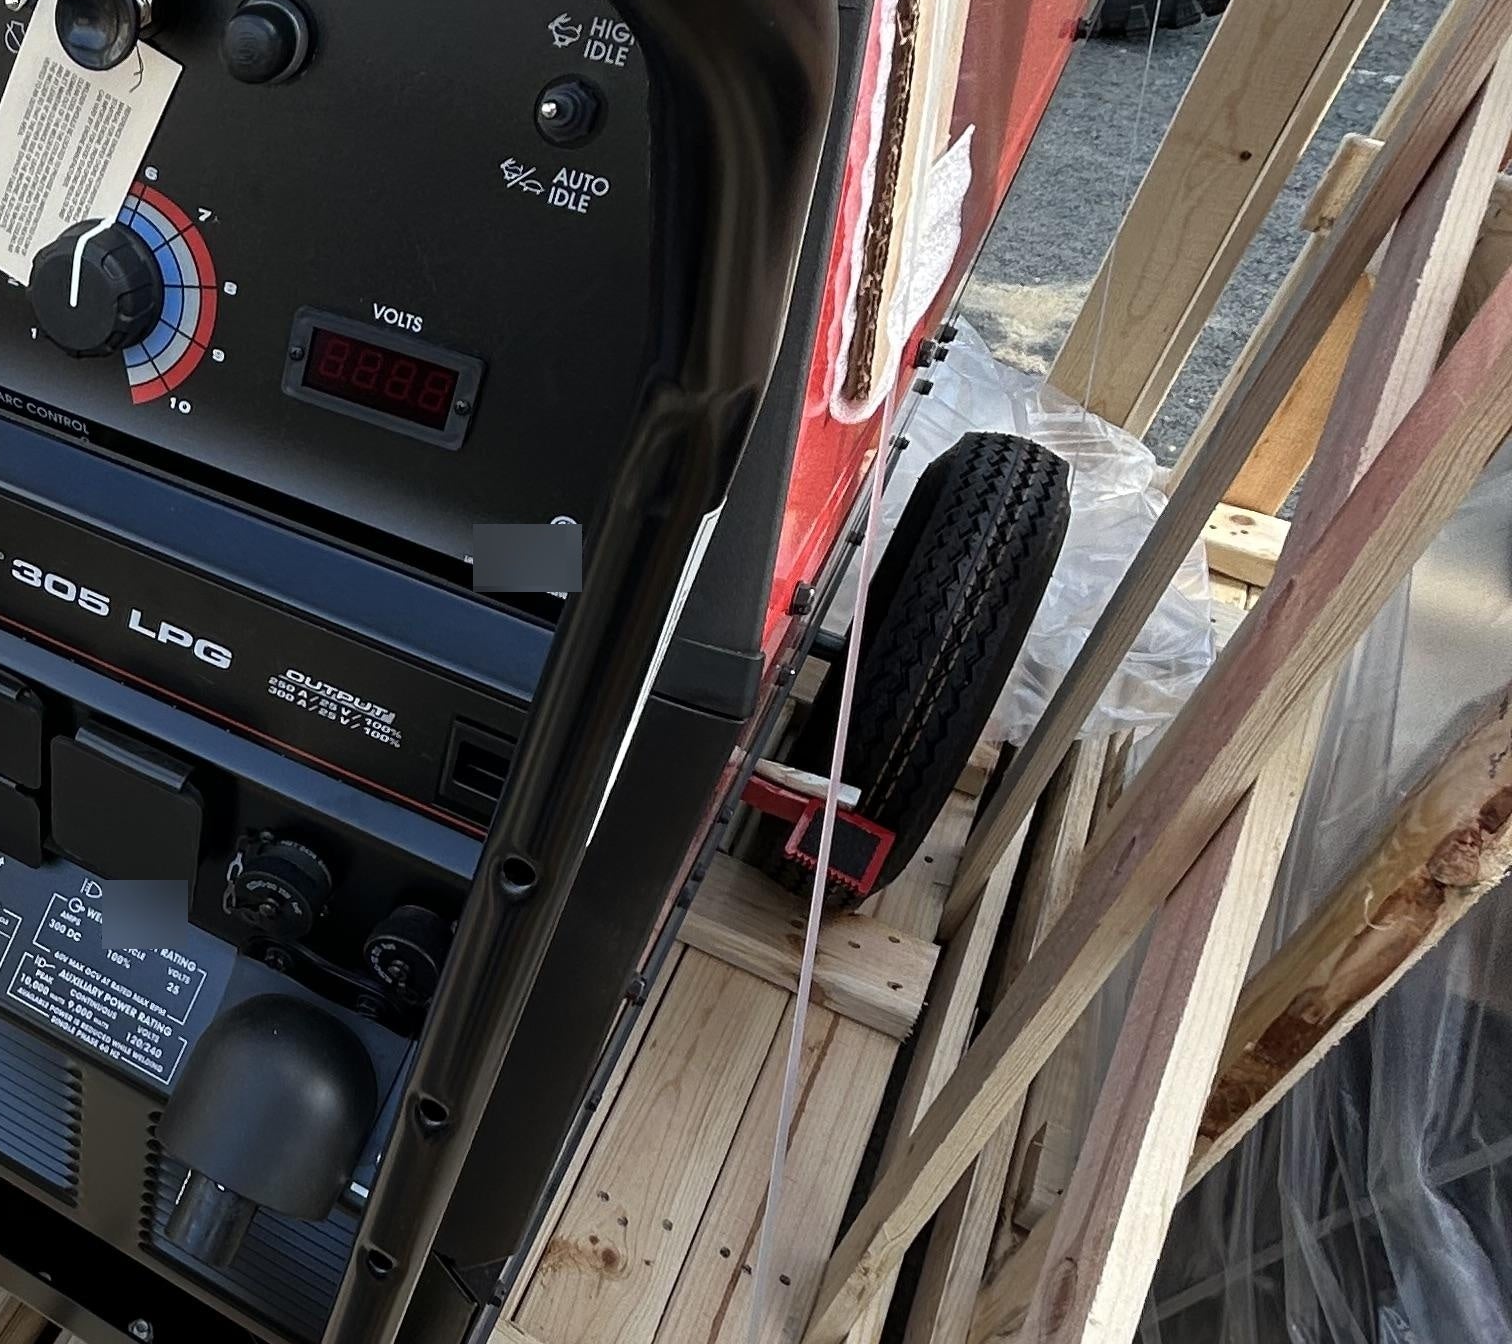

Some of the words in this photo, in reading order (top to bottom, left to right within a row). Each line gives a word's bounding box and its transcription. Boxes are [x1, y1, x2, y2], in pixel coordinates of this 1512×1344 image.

[589, 17, 635, 45] HIG
[584, 39, 629, 67] IDLE
[145, 166, 159, 181] 6
[552, 167, 610, 196] AUTO
[548, 186, 591, 213] IDLE
[197, 207, 212, 222] 7
[224, 281, 237, 296] 8
[373, 303, 424, 333] VOLTS
[29, 327, 39, 340] 1
[212, 348, 225, 363] 9
[169, 397, 192, 414] 10
[26, 402, 90, 434] CONTROL
[11, 559, 110, 618] 305
[128, 608, 234, 669] LPG
[268, 686, 295, 702] 300
[60, 910, 81, 926] AMPS
[49, 919, 66, 934] 300
[66, 928, 82, 942] DC
[107, 949, 130, 969] 100%
[168, 967, 191, 984] VOLTS
[166, 982, 180, 996] 25
[59, 969, 102, 998] AUXILIARY
[104, 993, 137, 1018] POWER
[138, 1012, 173, 1036] RATING
[69, 988, 117, 1019] CONTINUOUS
[137, 1024, 160, 1044] VOLTS
